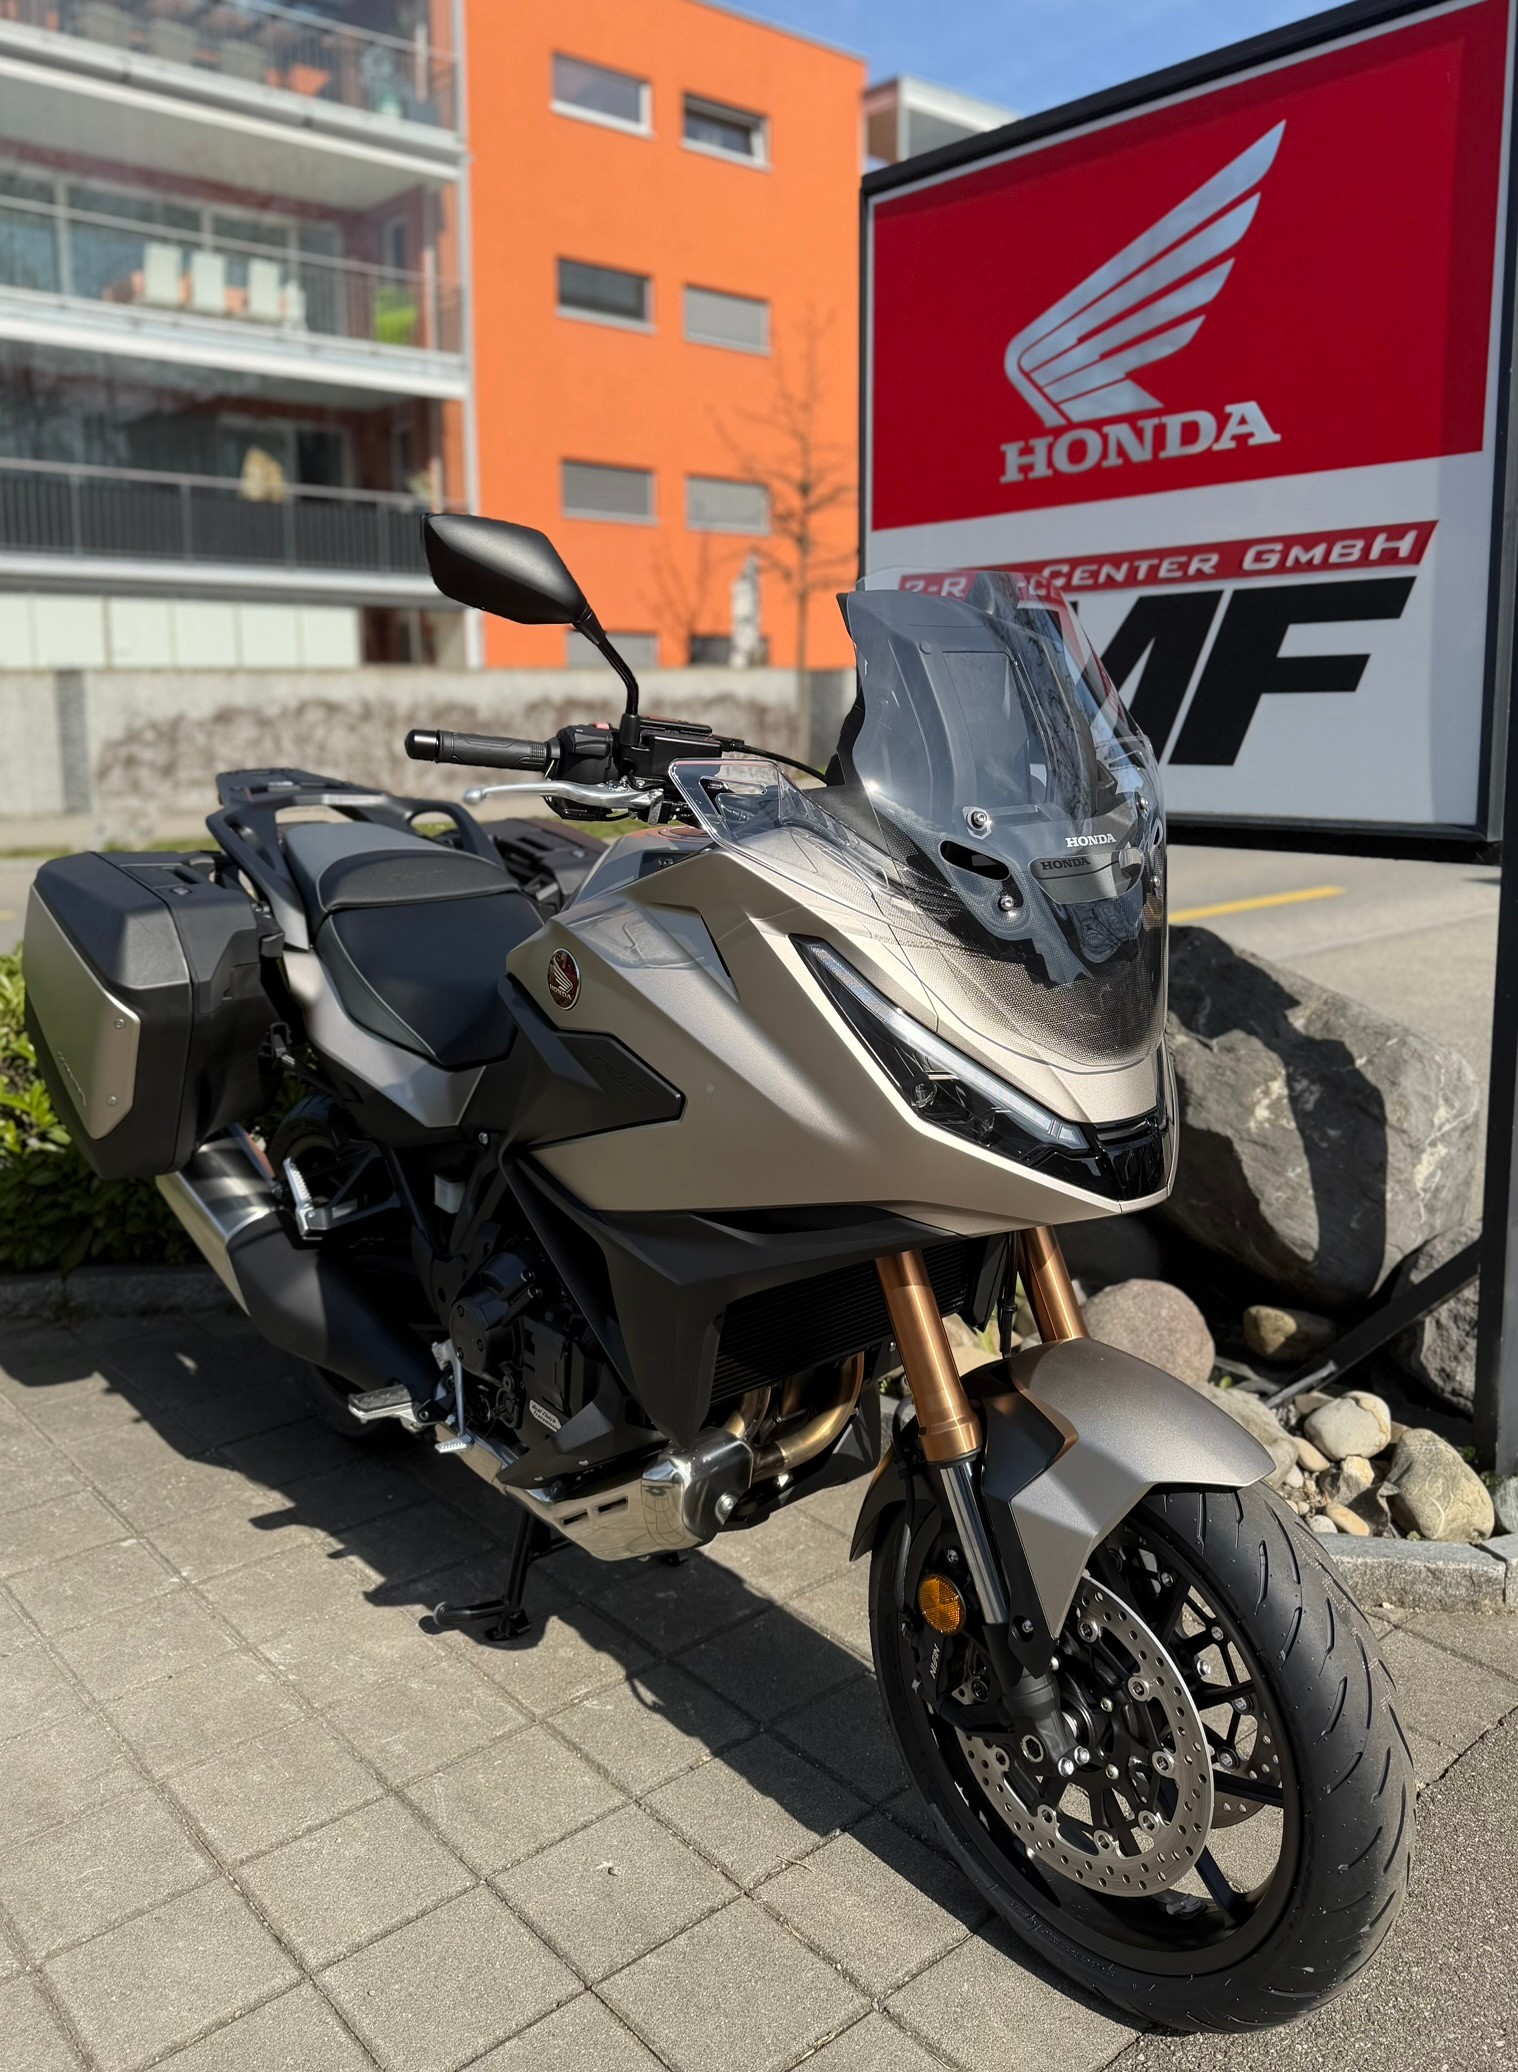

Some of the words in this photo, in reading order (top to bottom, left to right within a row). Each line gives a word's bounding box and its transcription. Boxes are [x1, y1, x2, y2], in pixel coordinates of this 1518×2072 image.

[999, 400, 1281, 483] HONDA
[1065, 833, 1117, 848] HONDA
[1041, 857, 1091, 871] HONDA
[550, 983, 572, 1000] HONDA
